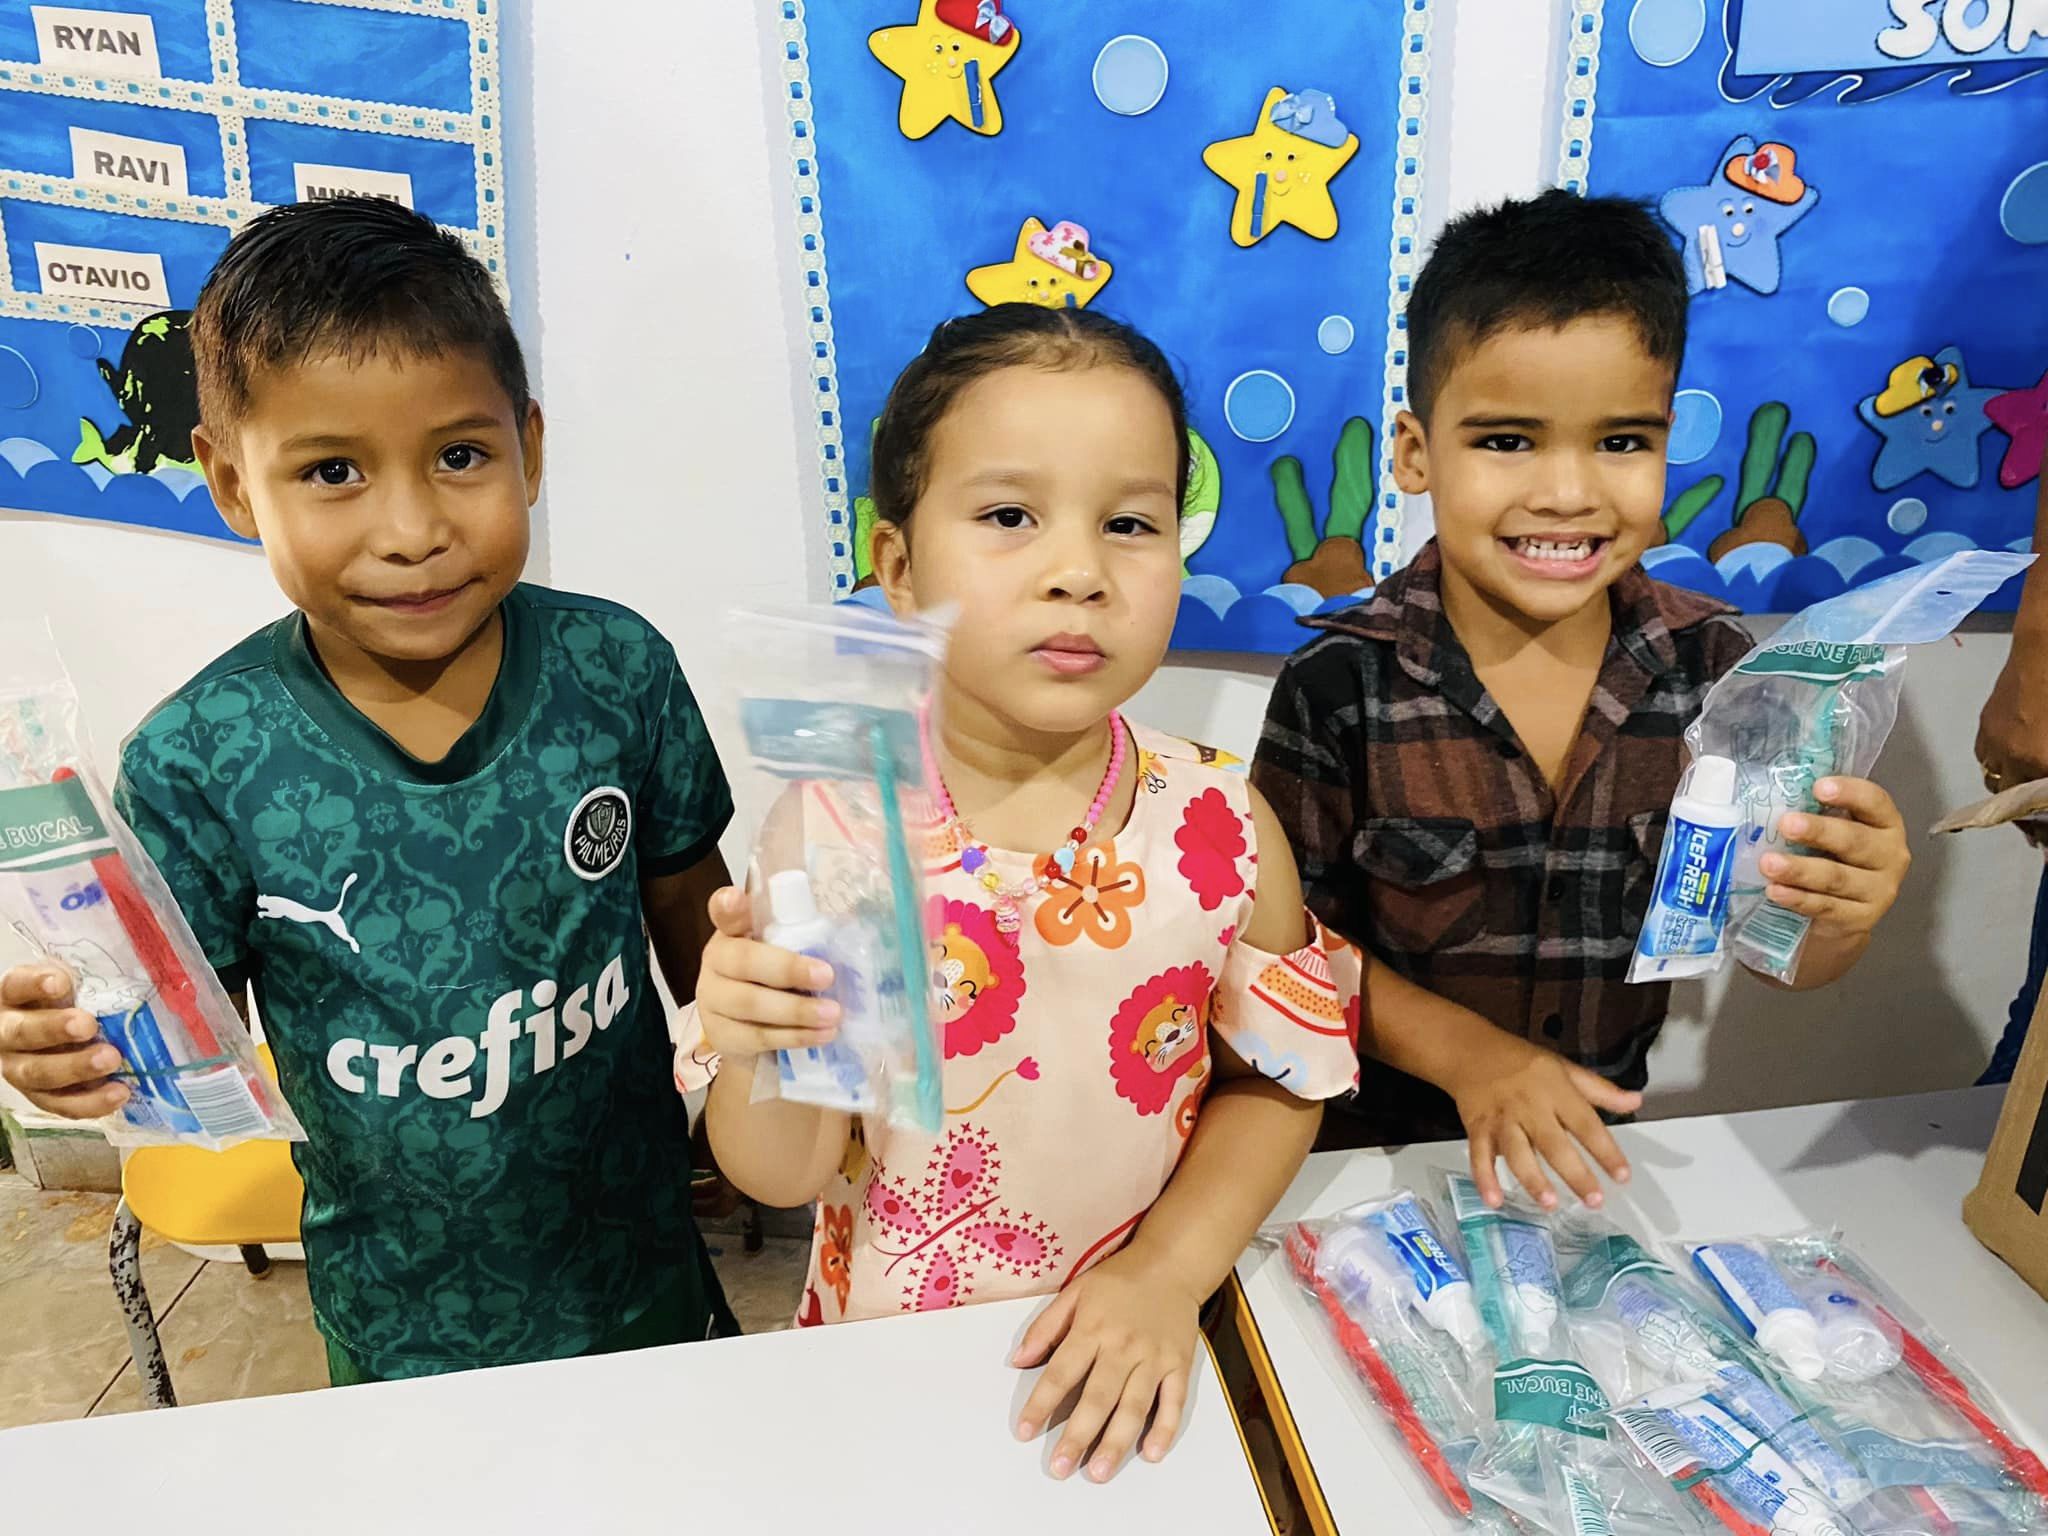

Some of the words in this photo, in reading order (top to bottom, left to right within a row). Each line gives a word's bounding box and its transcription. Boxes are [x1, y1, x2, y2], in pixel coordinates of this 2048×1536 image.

[53, 25, 141, 56] RYAN
[94, 150, 170, 186] RAVI
[48, 262, 150, 291] OTAVIO
[5, 815, 94, 848] BUCAL
[575, 819, 626, 866] PALMEIRAS
[326, 953, 630, 1118] crefisa
[1501, 1375, 1572, 1397] BUCAL
